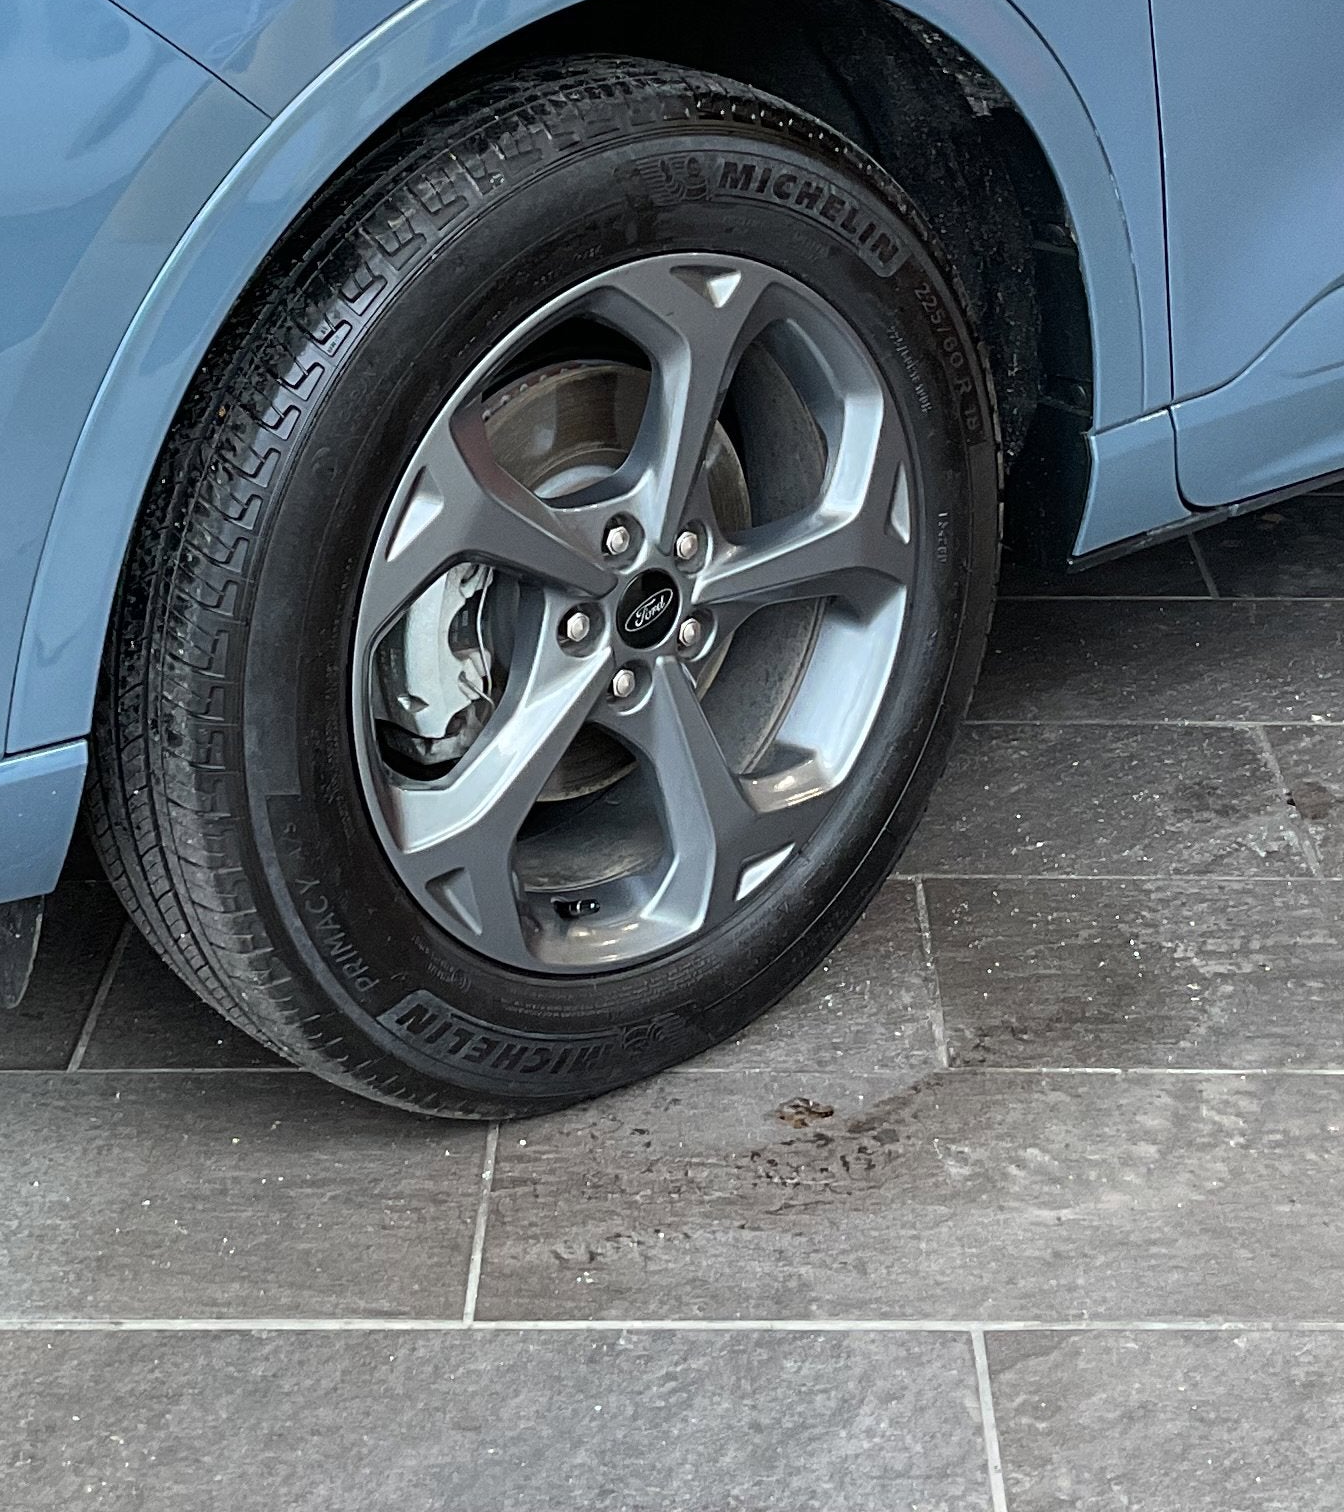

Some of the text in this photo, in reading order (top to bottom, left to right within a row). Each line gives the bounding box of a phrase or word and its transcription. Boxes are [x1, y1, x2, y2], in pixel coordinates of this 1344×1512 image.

[718, 160, 901, 264] MICHELIN
[634, 594, 666, 627] Ford
[295, 878, 380, 992] PRIMACY
[394, 1002, 614, 1075] MICHELIN
